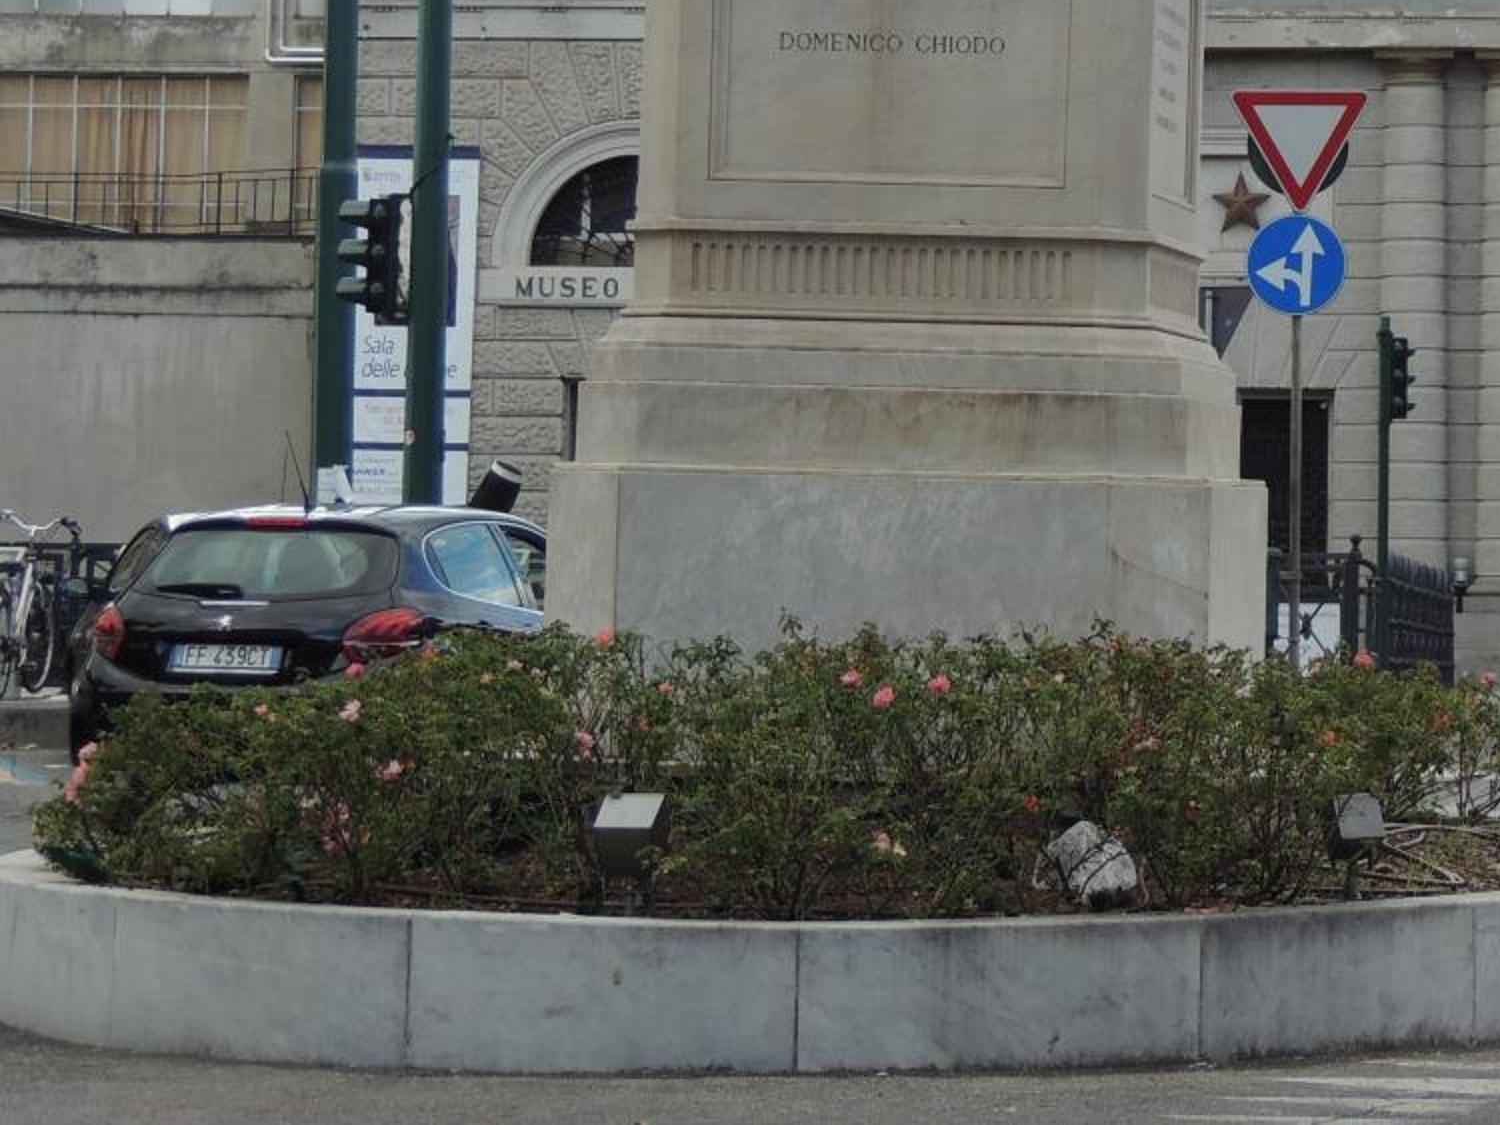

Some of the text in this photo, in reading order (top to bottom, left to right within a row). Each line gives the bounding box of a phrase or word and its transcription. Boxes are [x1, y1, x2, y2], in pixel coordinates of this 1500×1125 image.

[779, 31, 1006, 55] DOMENICO CHIODO
[515, 276, 620, 298] MUSEO
[362, 334, 395, 355] Sala
[361, 357, 401, 378] delle
